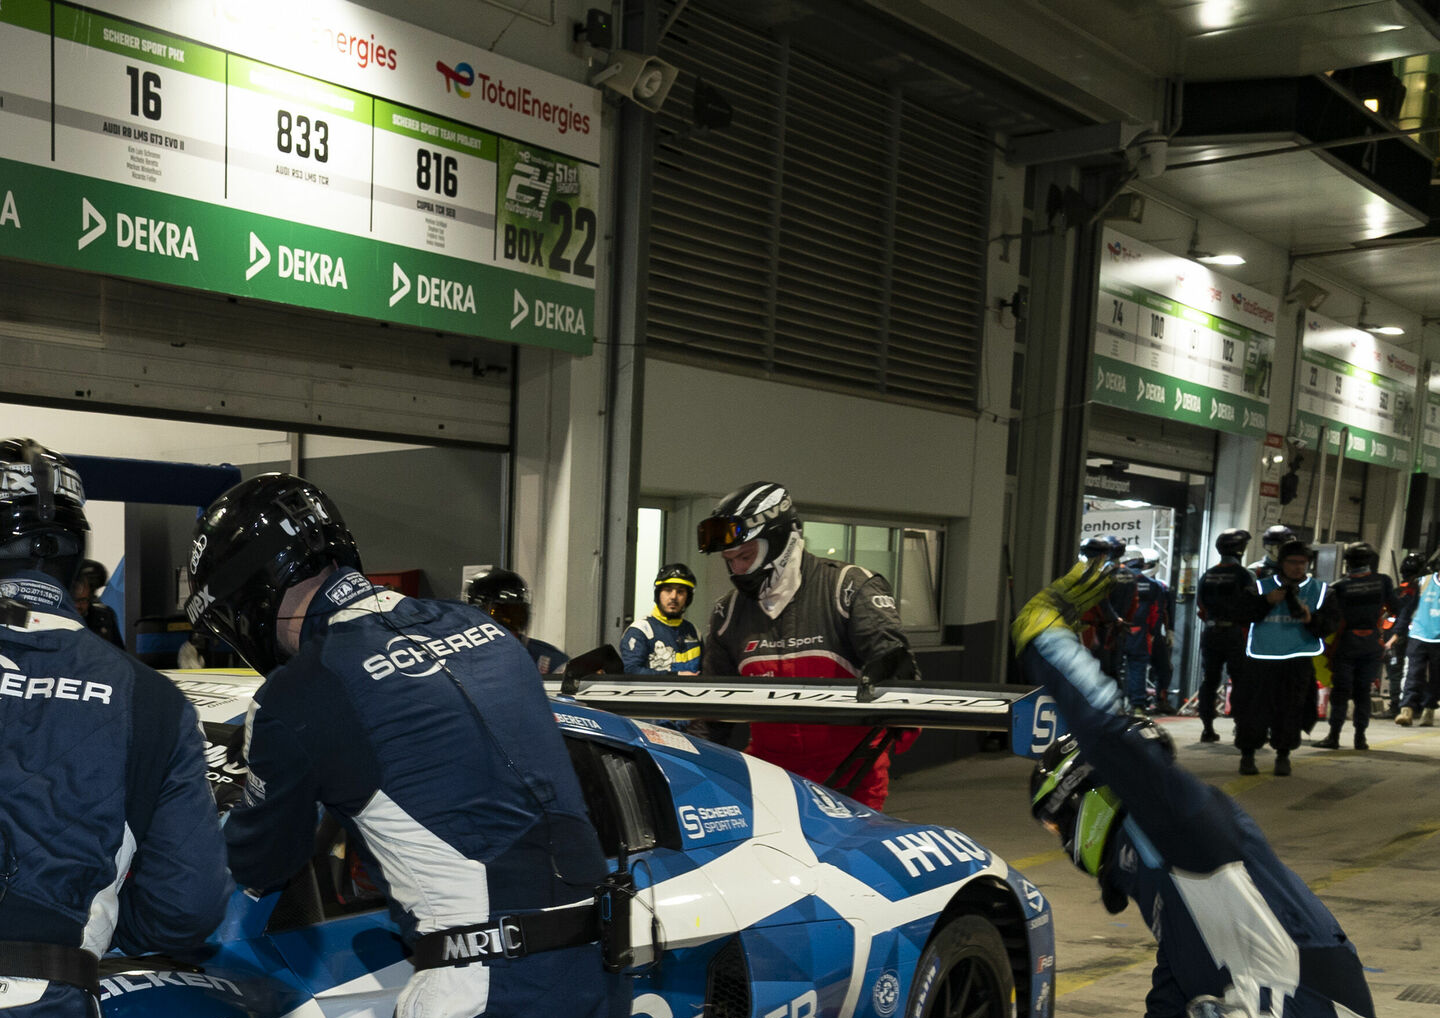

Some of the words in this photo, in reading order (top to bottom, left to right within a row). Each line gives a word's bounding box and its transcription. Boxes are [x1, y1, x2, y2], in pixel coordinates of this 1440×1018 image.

[103, 28, 140, 50] SCHERER
[142, 38, 167, 58] SPORT
[168, 46, 184, 63] PHX
[126, 65, 162, 121] 16
[479, 73, 590, 135] TotalEnergies
[103, 121, 120, 136] AUDI
[133, 129, 148, 142] LMS
[277, 109, 329, 163] 833
[416, 148, 458, 198] 816
[116, 211, 200, 262] DEKRA
[504, 223, 545, 268] BOX
[548, 200, 597, 280] 22
[278, 245, 348, 290] DEKRA
[417, 273, 477, 315] DEKRA
[535, 298, 586, 337] DEKRA
[1105, 372, 1126, 393] DEKRA
[1146, 383, 1166, 404] DEKRA
[1182, 393, 1202, 413] DEKRA
[1217, 402, 1235, 422] DEKRA
[1082, 520, 1141, 533] enhorst
[363, 622, 507, 681] SCHERER
[759, 638, 786, 650] Audi
[788, 634, 824, 649] Sport
[578, 689, 755, 699] DENT
[559, 712, 602, 731] BERETTA
[206, 772, 234, 785] OP
[698, 806, 742, 819] SCHERER
[704, 820, 732, 834] SPORT
[732, 818, 748, 830] PHX
[882, 829, 988, 878] HYLO
[442, 925, 522, 961] MRTC
[100, 971, 244, 1001] ALKEN
